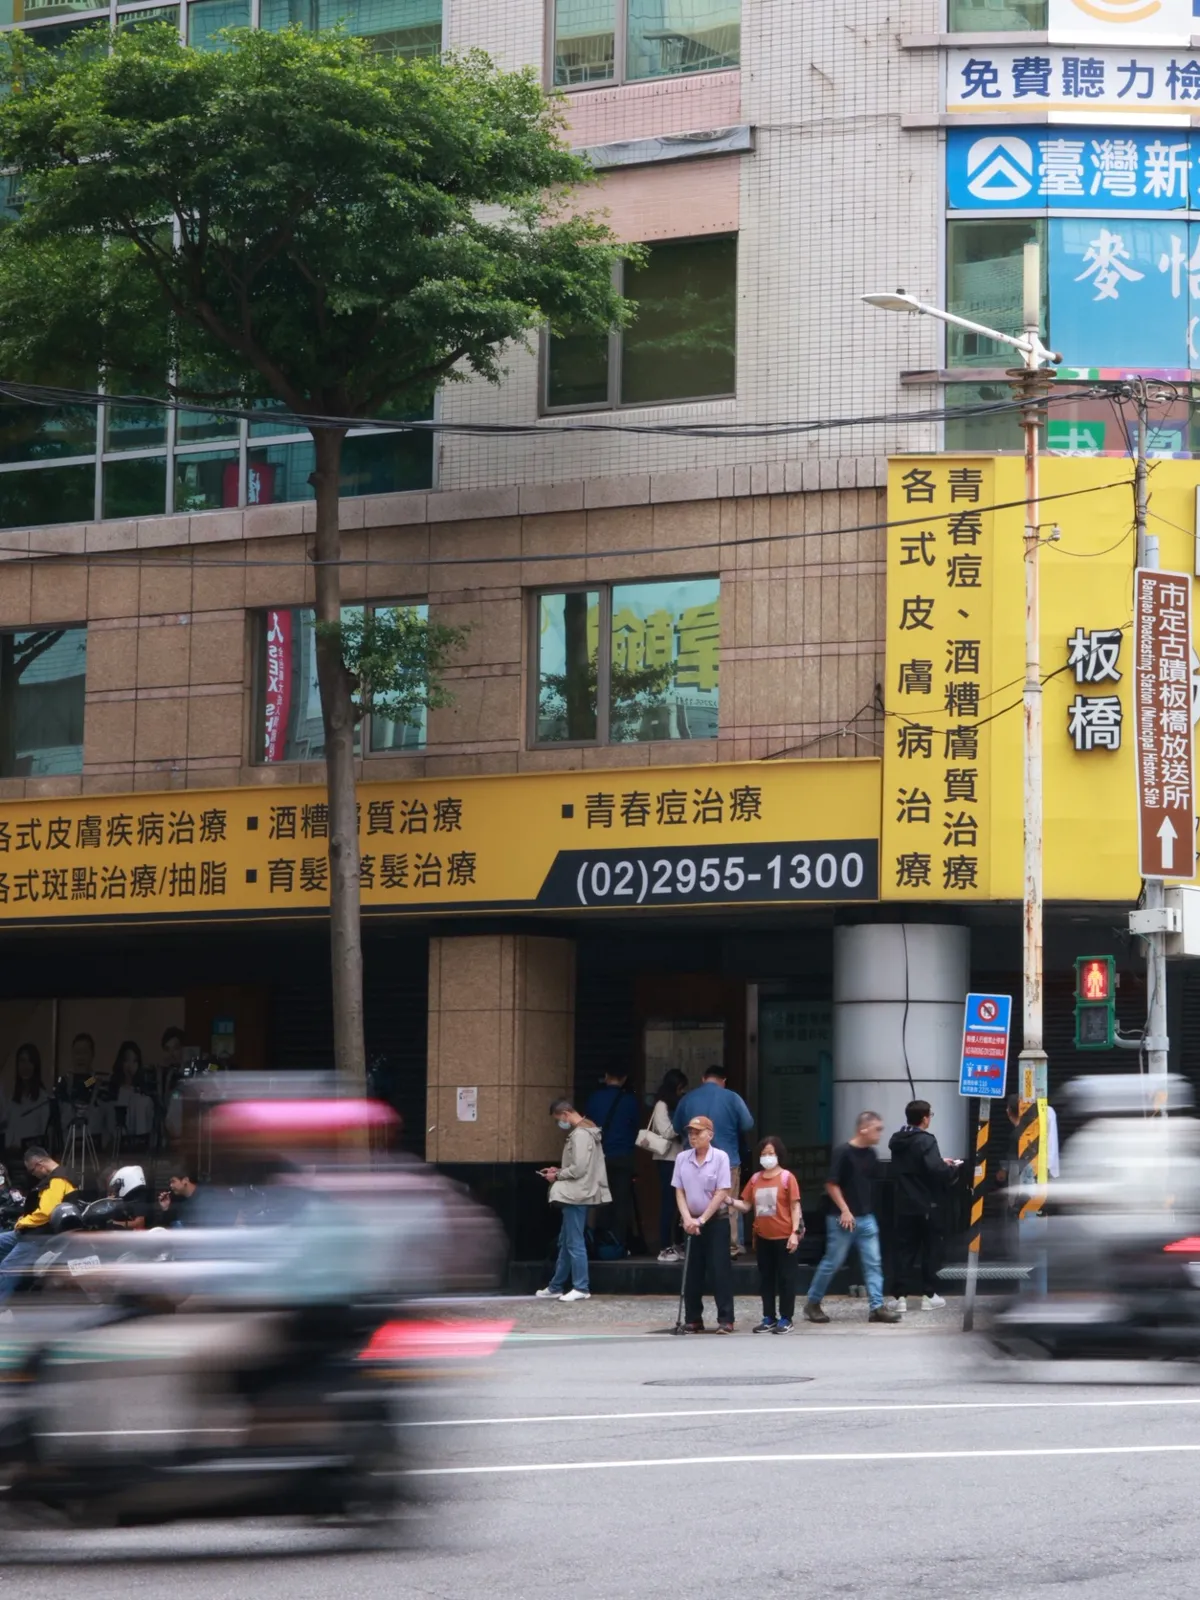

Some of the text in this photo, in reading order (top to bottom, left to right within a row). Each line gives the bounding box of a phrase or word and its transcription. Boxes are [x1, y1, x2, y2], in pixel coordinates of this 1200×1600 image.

[896, 468, 937, 889] 各式皮膚病治療
[943, 467, 983, 892] 青春痘、酒糟膚質治療
[1068, 628, 1124, 751] 板橋
[1136, 579, 1160, 808] Banqiao Broadcasting Station (Municipal Historic Site)
[1158, 582, 1190, 811] 市定古蹟板橋放送所
[0, 808, 229, 853] 各式皮膚疾病治療
[268, 796, 464, 840] 酒糟質治療
[585, 784, 764, 830] 青春痘治療
[0, 860, 228, 904] 各式斑點治療/抽脂
[575, 852, 864, 904] (02)2955-1300
